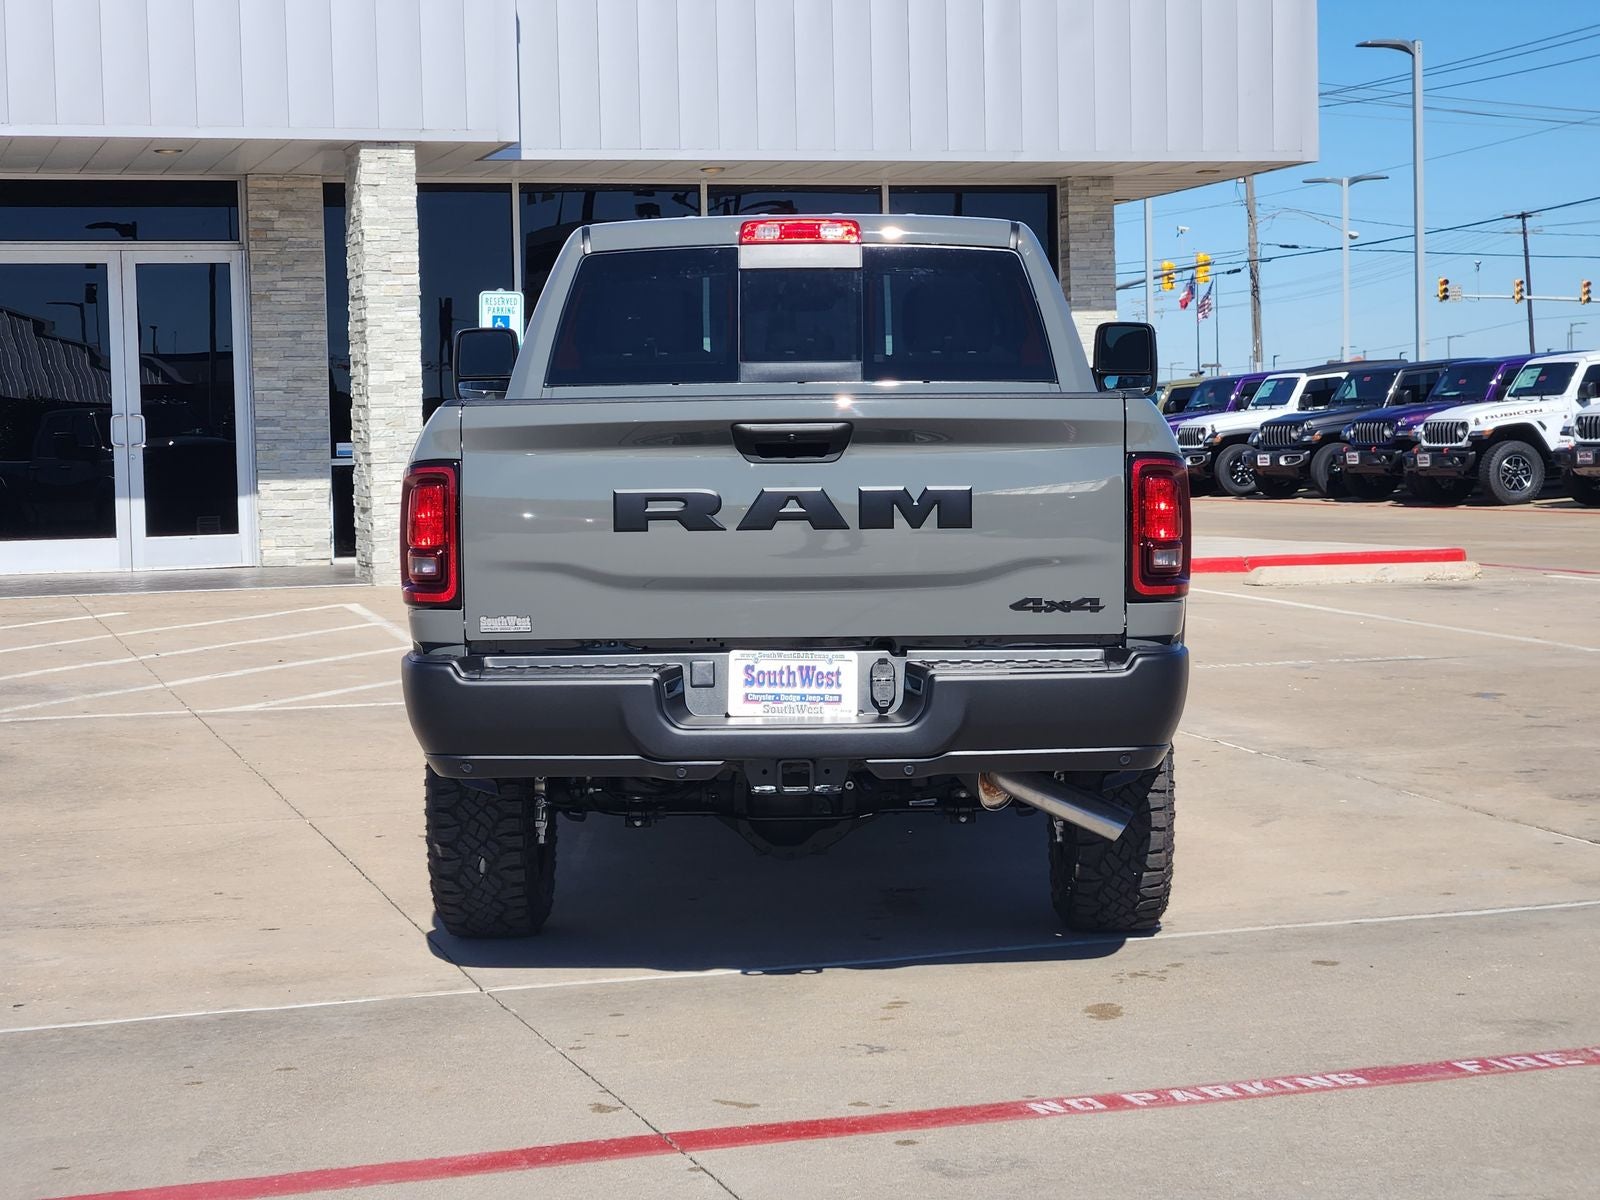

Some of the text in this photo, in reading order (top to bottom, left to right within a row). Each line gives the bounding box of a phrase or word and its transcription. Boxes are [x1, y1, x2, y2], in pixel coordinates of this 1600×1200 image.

[1484, 408, 1543, 420] RUBICON
[612, 485, 973, 533] RAM
[1009, 596, 1106, 614] 4x4
[480, 616, 531, 626] SouthWest
[744, 664, 842, 688] SouthWest
[747, 693, 839, 702] Chrysler Dodge Jeep Ram
[762, 704, 824, 714] SouthWest
[1029, 1053, 1586, 1115] NO PARKING FIRE
